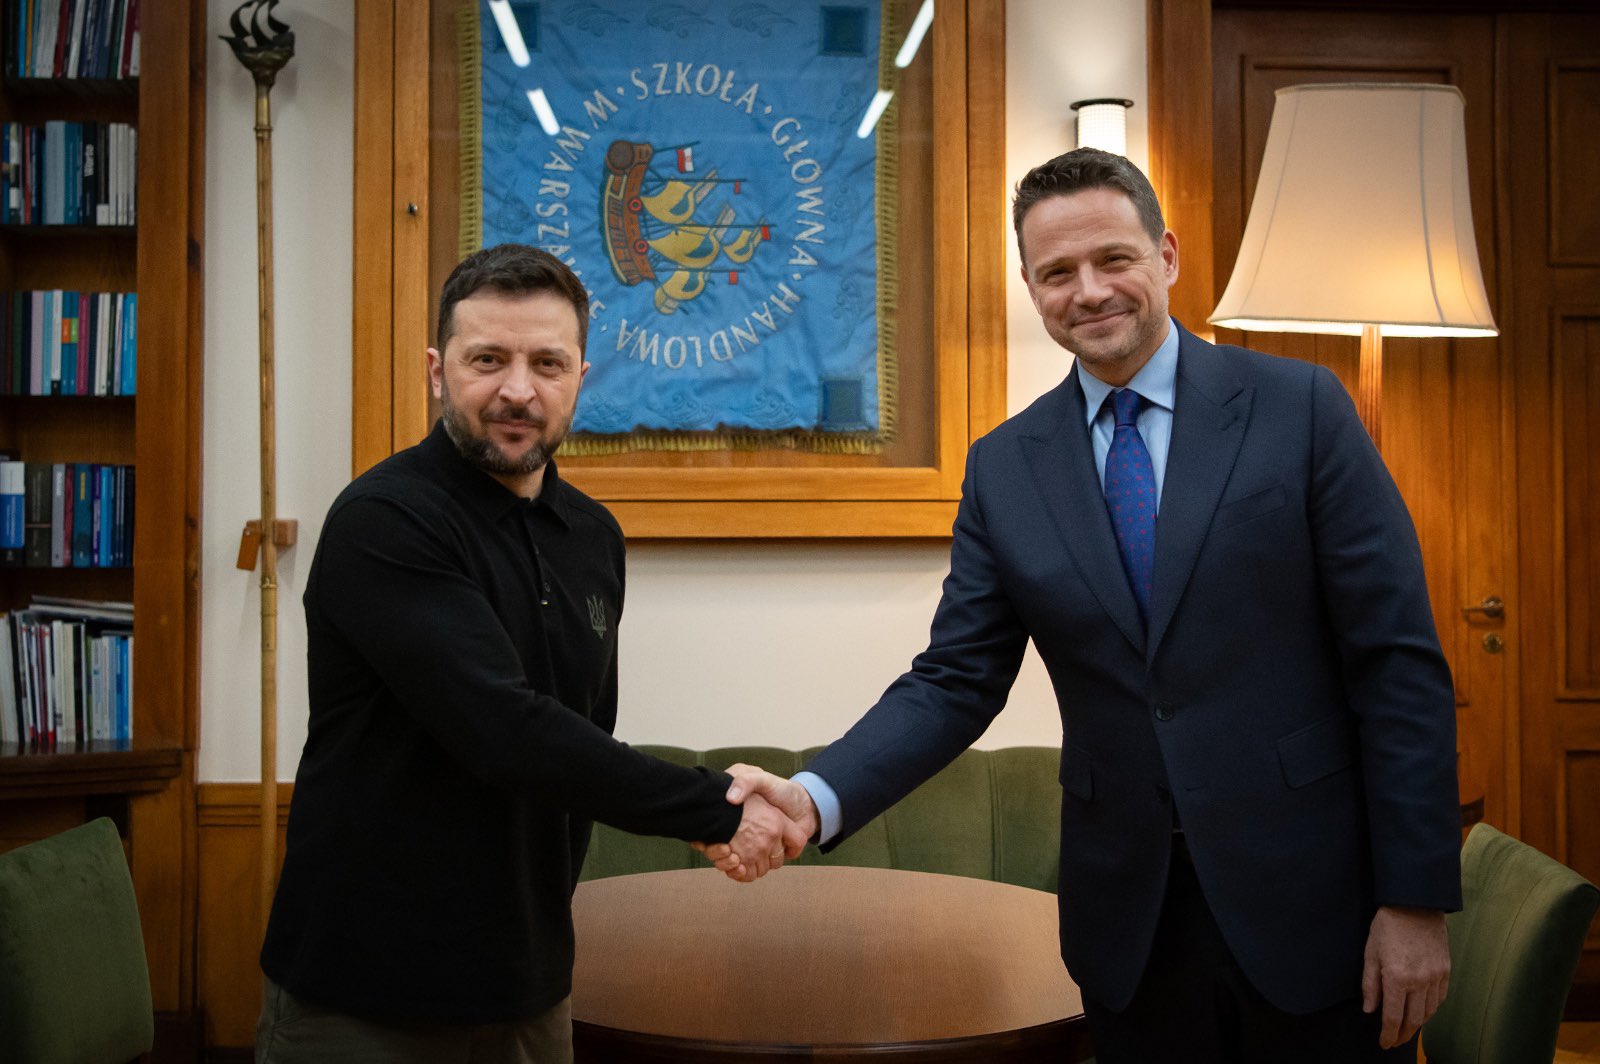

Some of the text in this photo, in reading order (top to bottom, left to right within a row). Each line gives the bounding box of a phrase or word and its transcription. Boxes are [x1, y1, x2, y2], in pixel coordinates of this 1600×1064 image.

[583, 90, 619, 130] W
[630, 61, 759, 114] SZKOŁA
[616, 283, 801, 369] HANDLOWA
